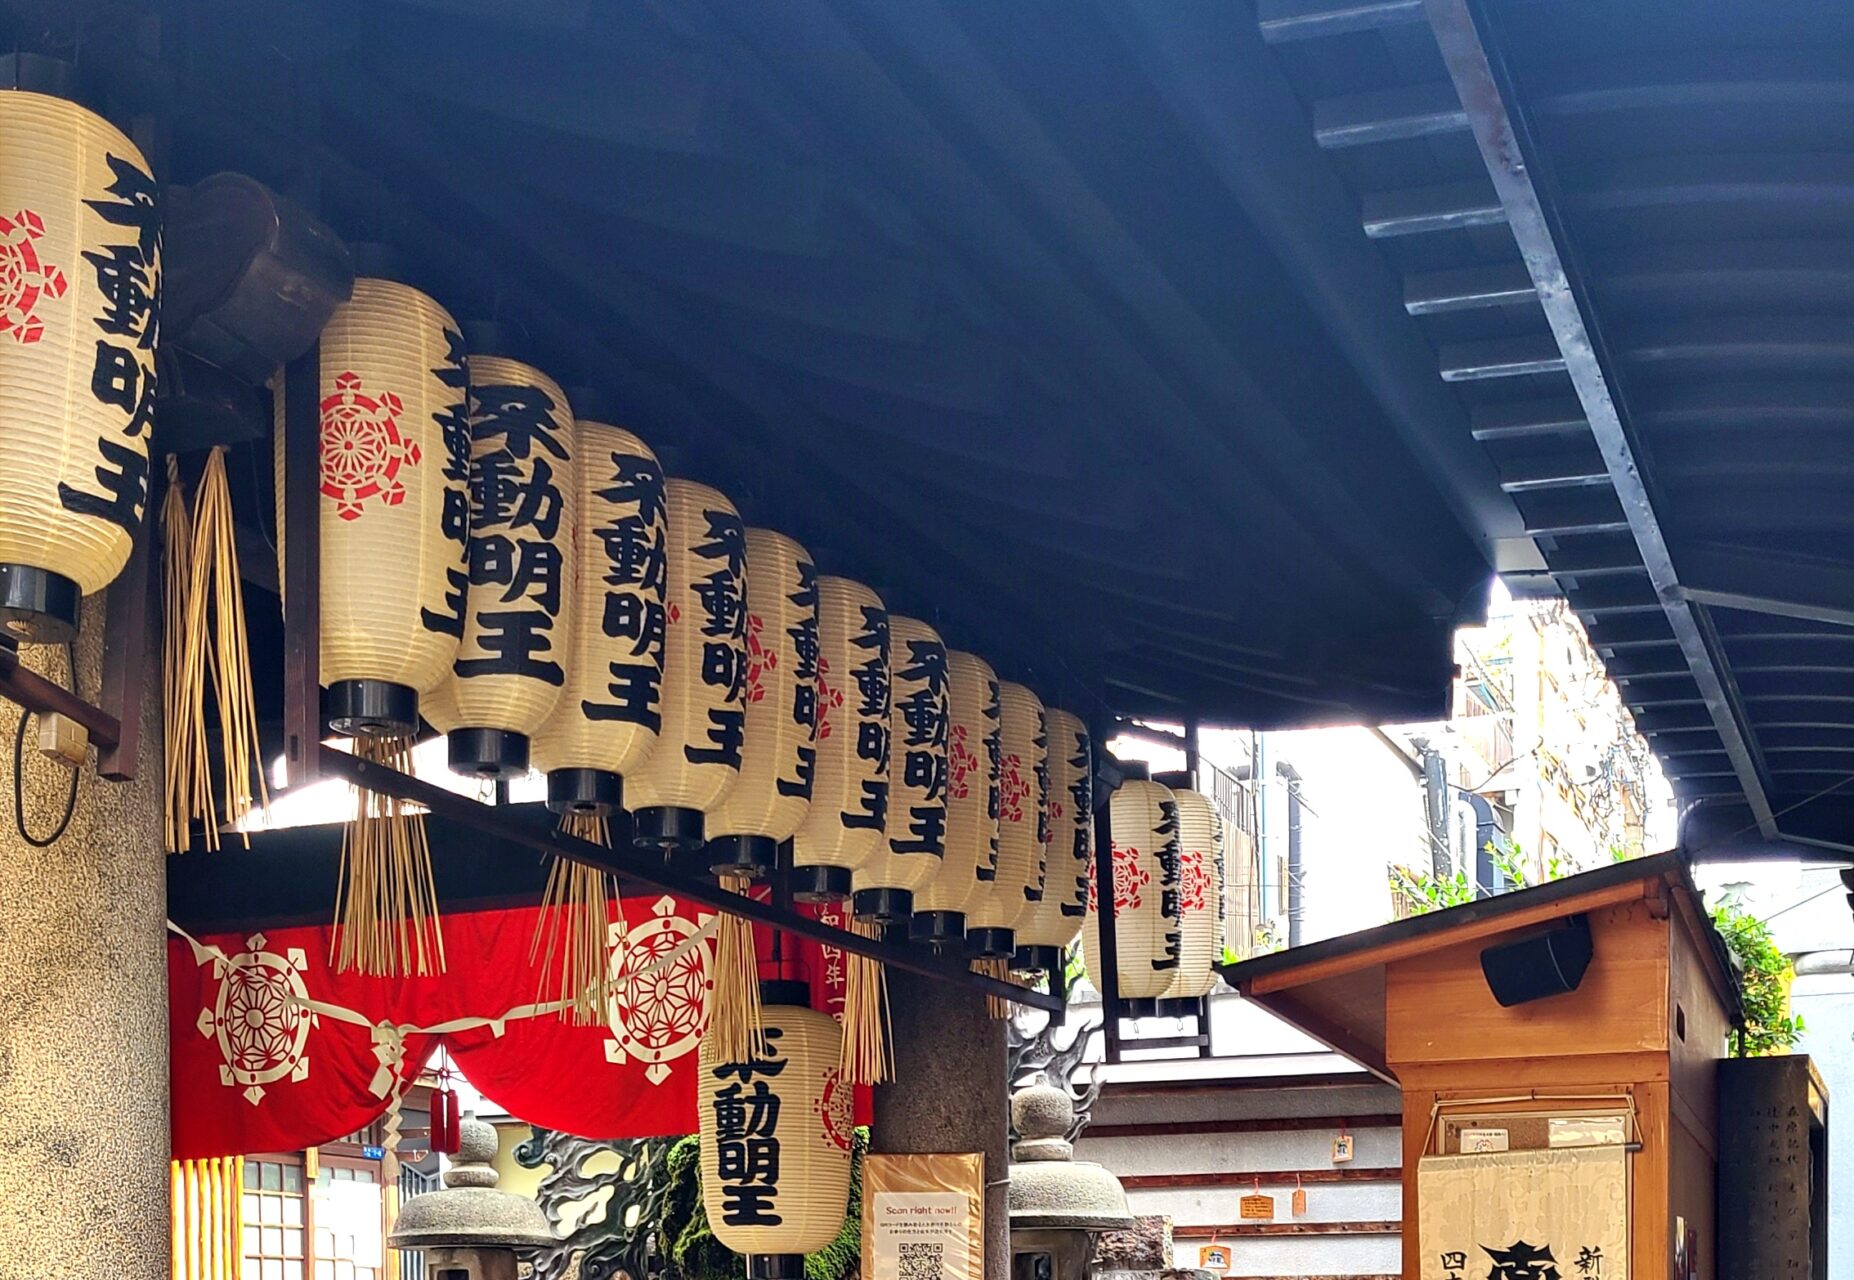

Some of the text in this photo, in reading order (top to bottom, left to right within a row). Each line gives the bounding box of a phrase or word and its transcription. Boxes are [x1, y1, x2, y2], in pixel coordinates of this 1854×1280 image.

[58, 152, 164, 528] 不動明王
[453, 384, 570, 687] 不動明王
[581, 452, 668, 736] 不動明王
[684, 508, 748, 772] 不動明王
[889, 640, 949, 859] 不動明王
[886, 1206, 908, 1215] Scan
[910, 1206, 932, 1217] right
